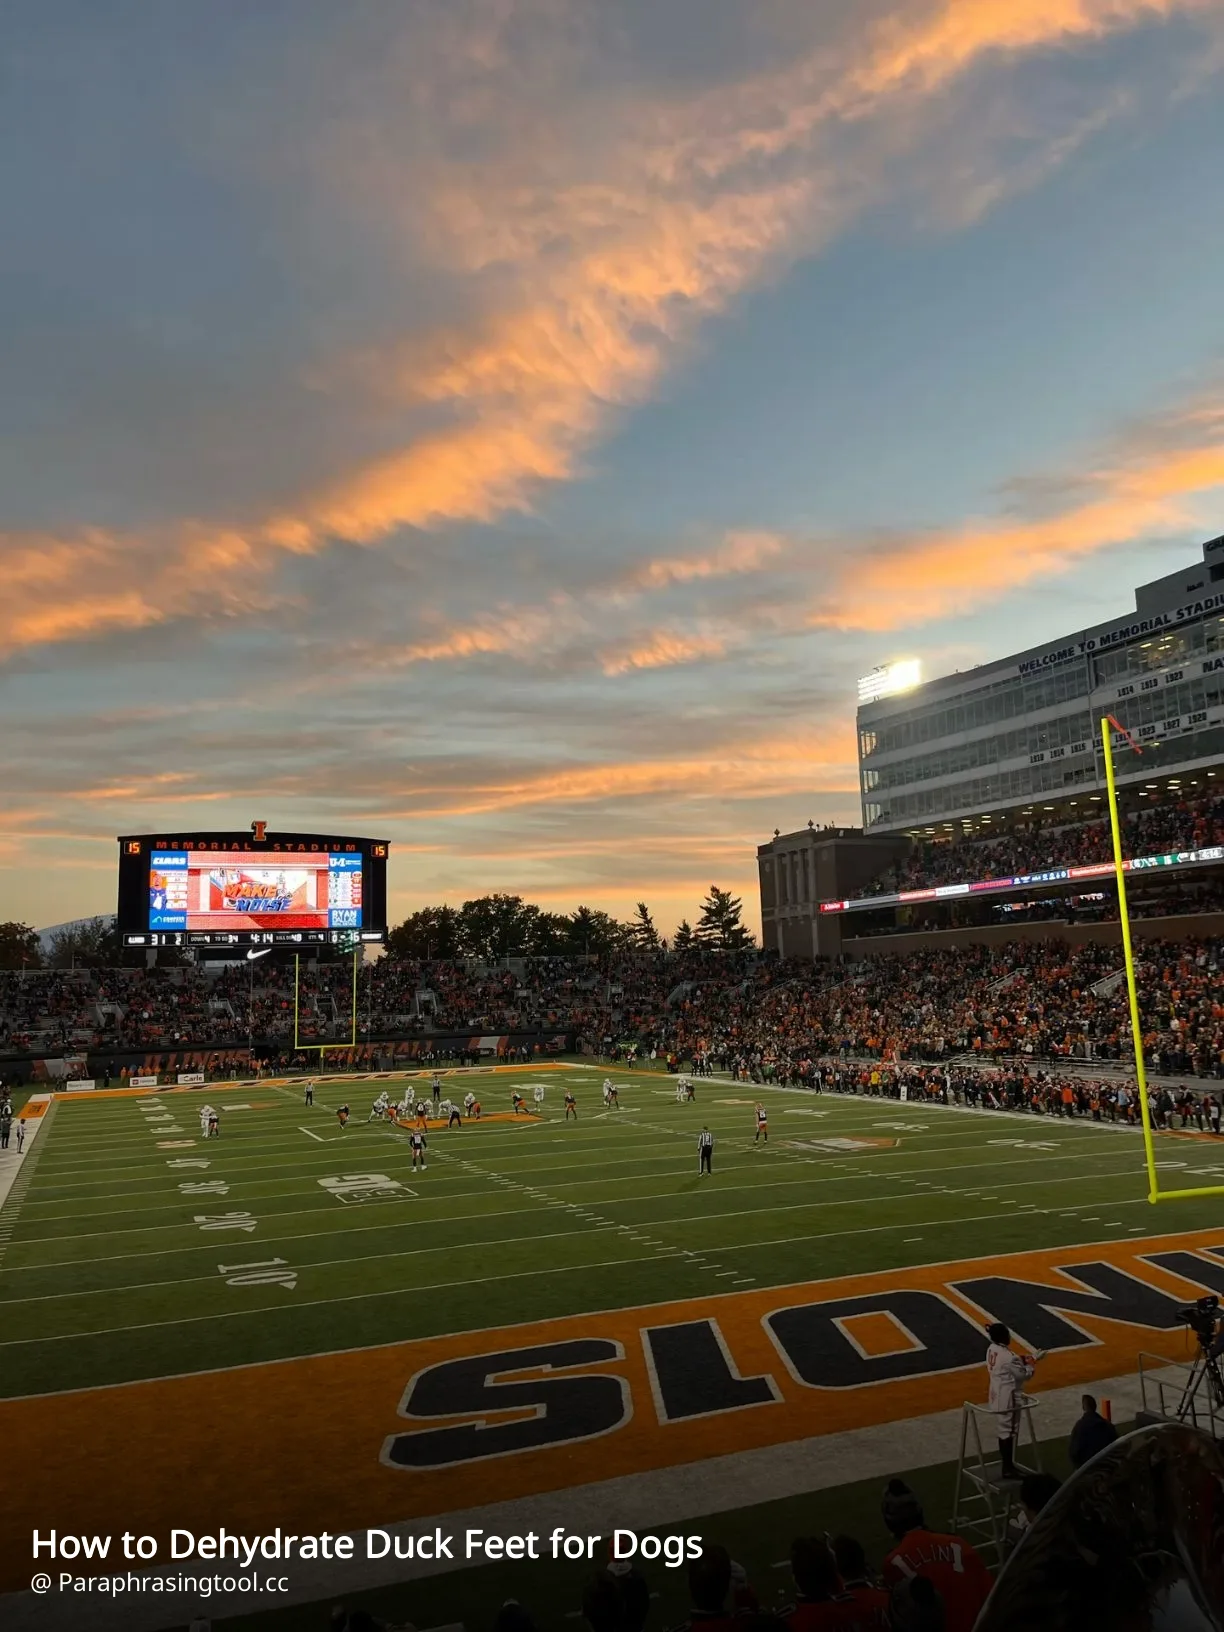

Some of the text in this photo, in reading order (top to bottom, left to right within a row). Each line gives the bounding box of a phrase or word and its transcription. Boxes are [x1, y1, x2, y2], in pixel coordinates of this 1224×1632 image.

[1018, 646, 1075, 673] WELCOME
[1078, 639, 1095, 652] TO
[1100, 614, 1171, 646] MEMORIAL
[1203, 656, 1224, 673] NA
[1165, 671, 1184, 684] 1923
[128, 842, 140, 853] 15
[156, 840, 356, 851] MEMORIAL STADIUM
[374, 845, 385, 856] 15
[222, 884, 277, 898] MAKE
[236, 897, 291, 911] NOISE
[250, 933, 274, 944] 4:14
[183, 1074, 203, 1083] Carle
[193, 1211, 258, 1230] 20
[217, 1257, 298, 1286] 10
